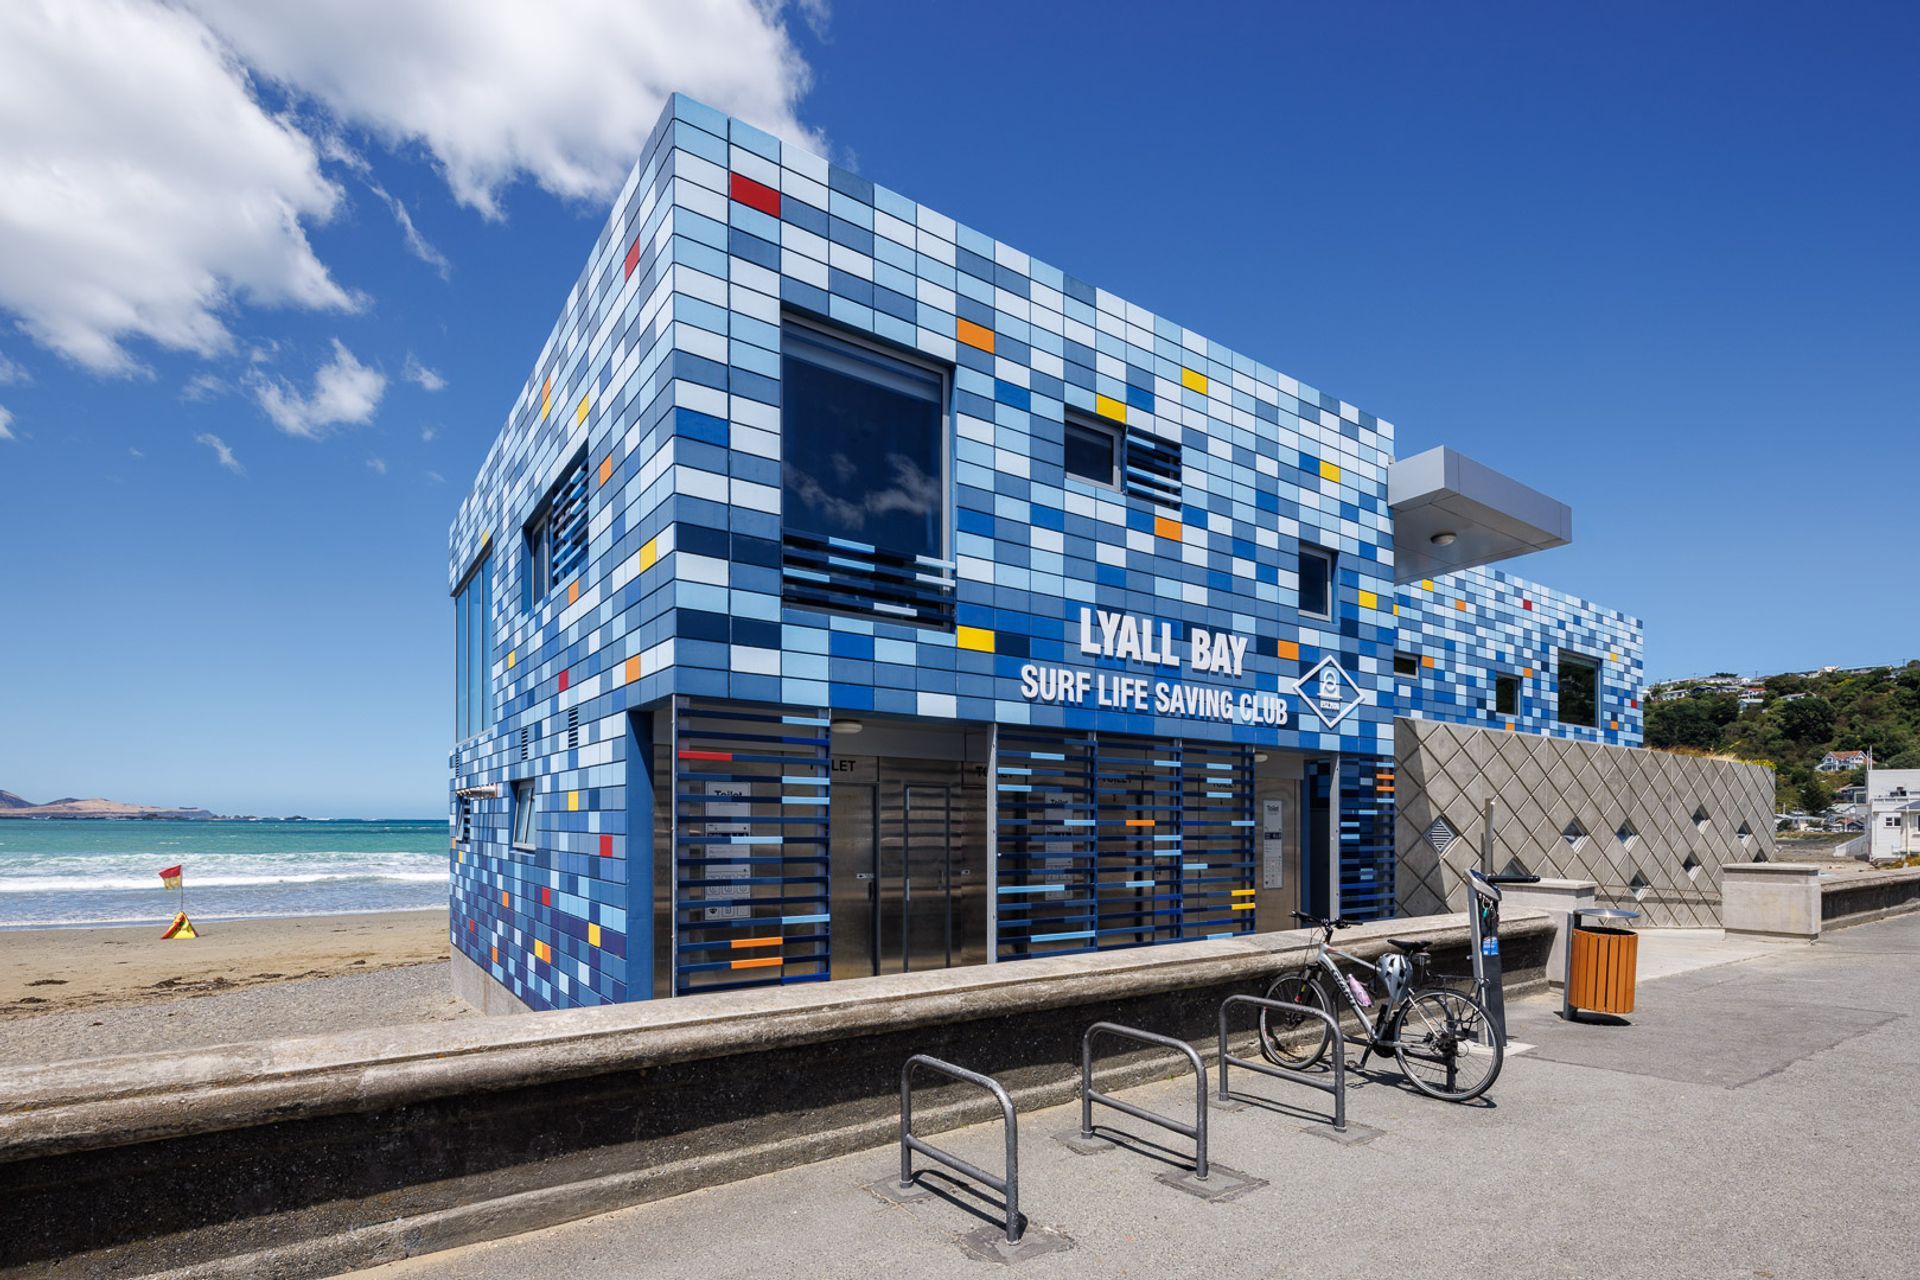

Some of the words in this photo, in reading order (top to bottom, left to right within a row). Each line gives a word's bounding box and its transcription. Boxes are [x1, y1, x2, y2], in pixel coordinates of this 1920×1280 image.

[1080, 607, 1181, 668] LYALL
[1191, 627, 1249, 677] BAY
[1021, 664, 1091, 703] SURF
[1098, 674, 1149, 711] LIFE
[1155, 682, 1234, 719] SAVING
[1240, 693, 1289, 726] CLUB
